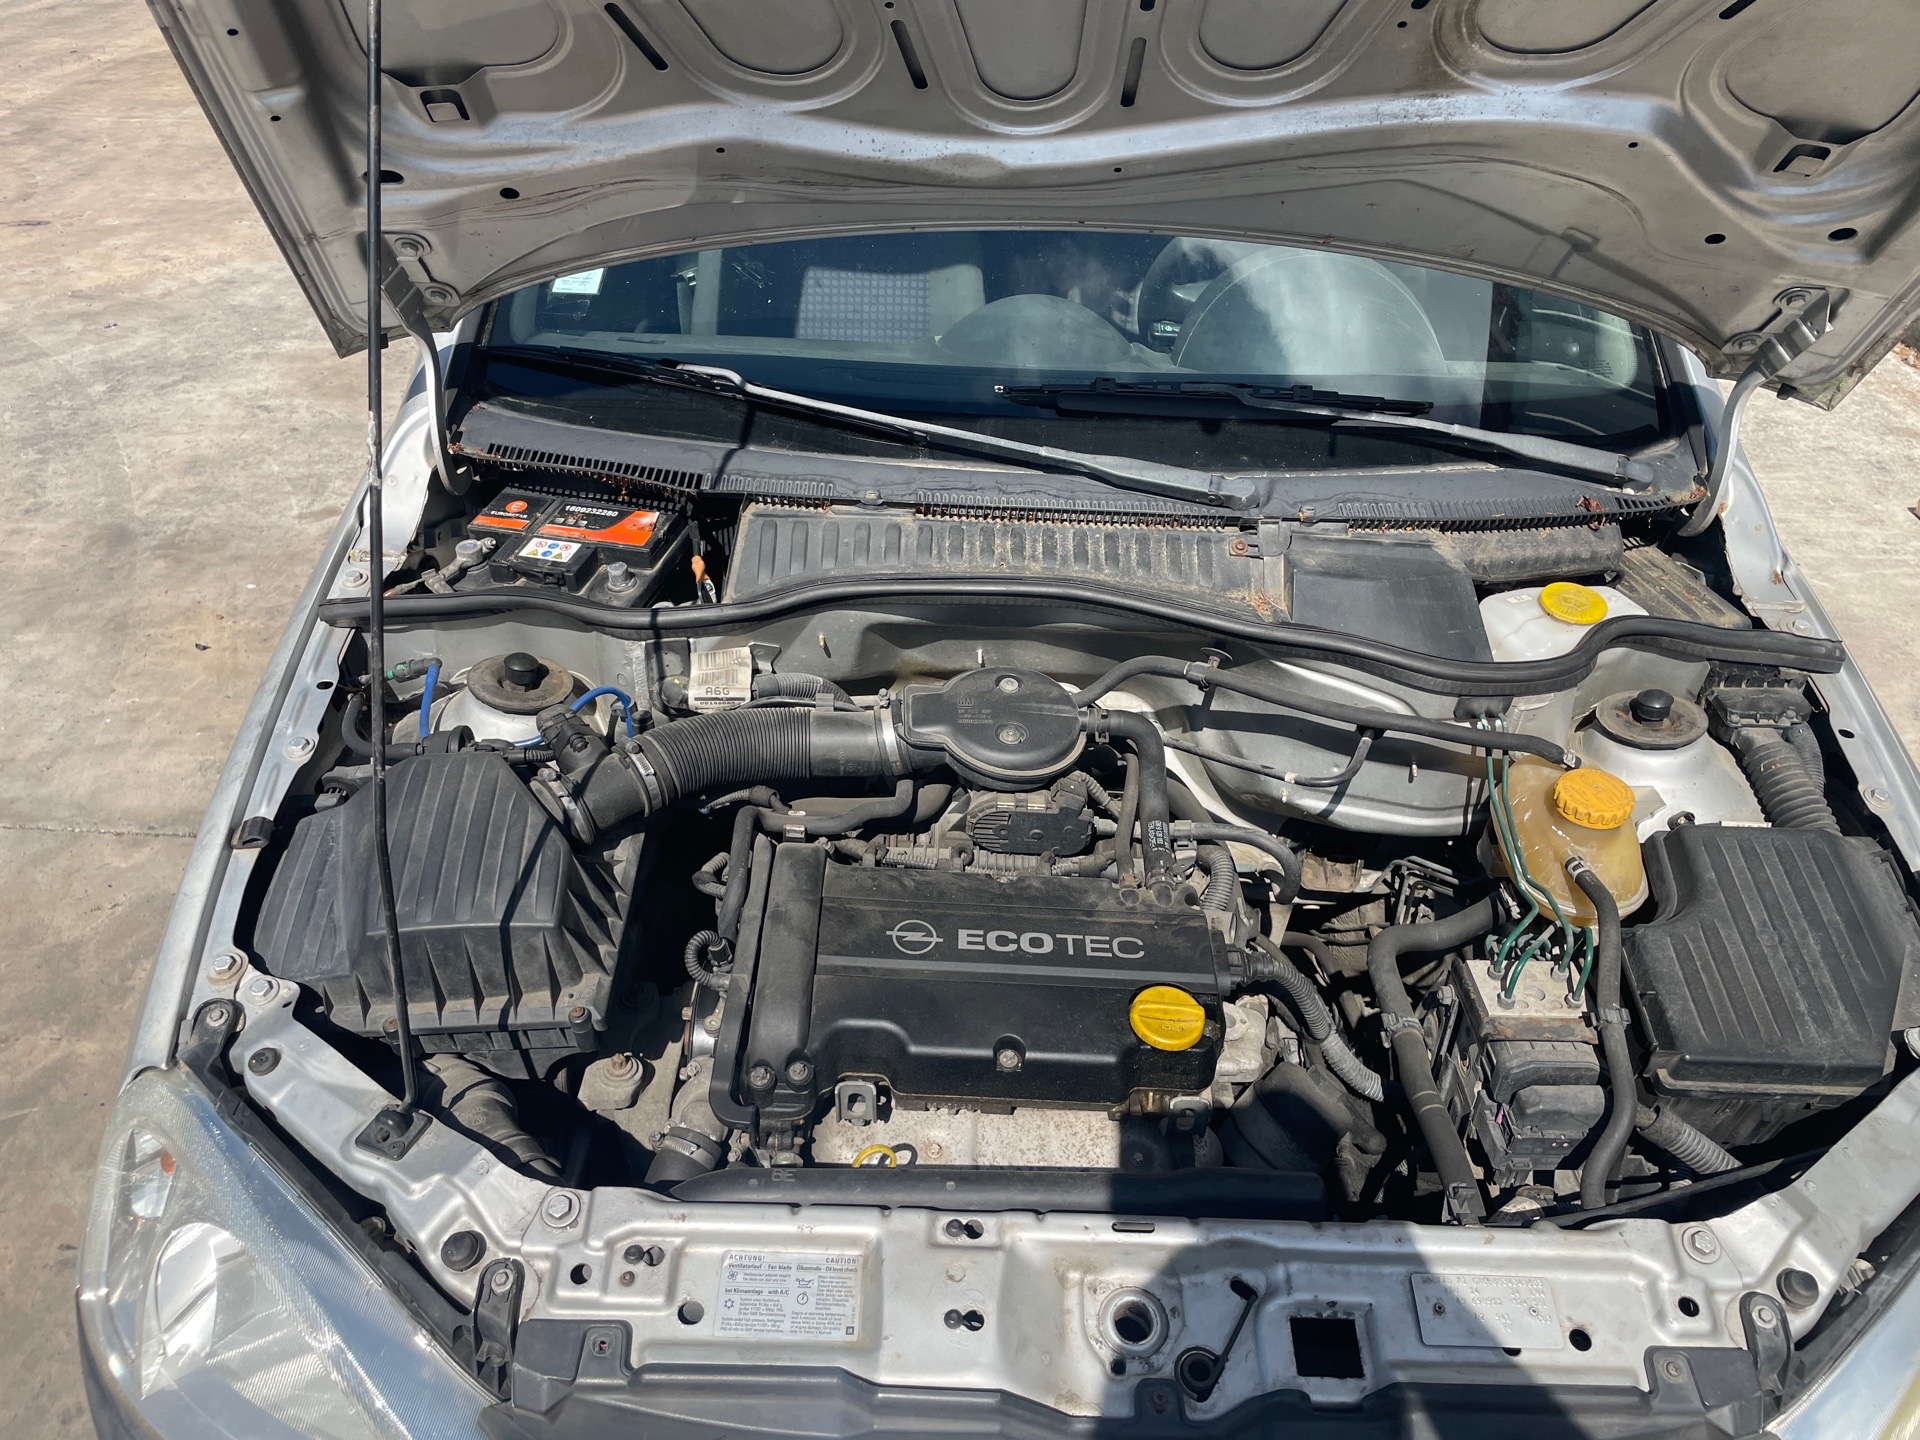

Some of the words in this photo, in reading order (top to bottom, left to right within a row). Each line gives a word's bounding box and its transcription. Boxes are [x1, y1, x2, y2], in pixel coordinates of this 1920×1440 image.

[565, 505, 618, 516] 1609232280
[706, 686, 730, 696] A6G
[958, 928, 1144, 958] ECOTEC
